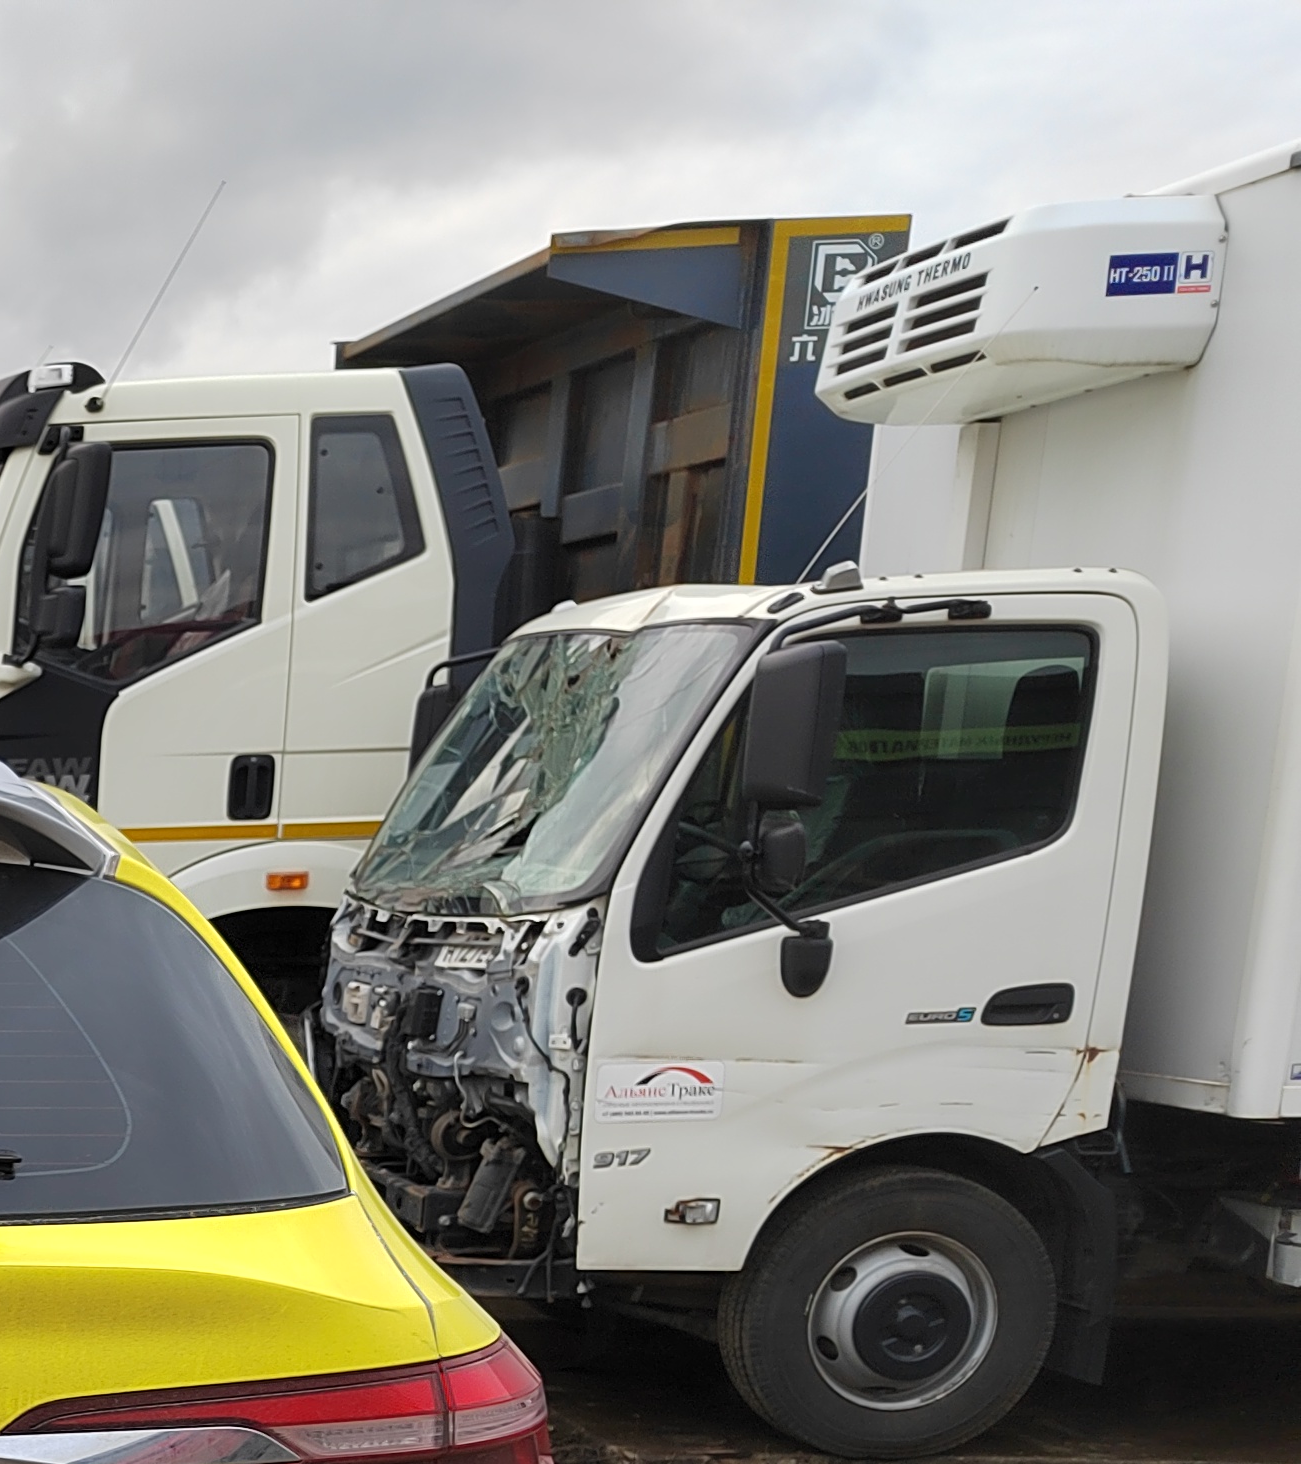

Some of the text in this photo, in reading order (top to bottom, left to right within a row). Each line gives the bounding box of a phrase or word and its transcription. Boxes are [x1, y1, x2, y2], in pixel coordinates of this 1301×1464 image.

[917, 252, 972, 288] THERMO
[1109, 265, 1161, 285] HT-250
[1183, 254, 1210, 281] H
[593, 1147, 652, 1169] 917
